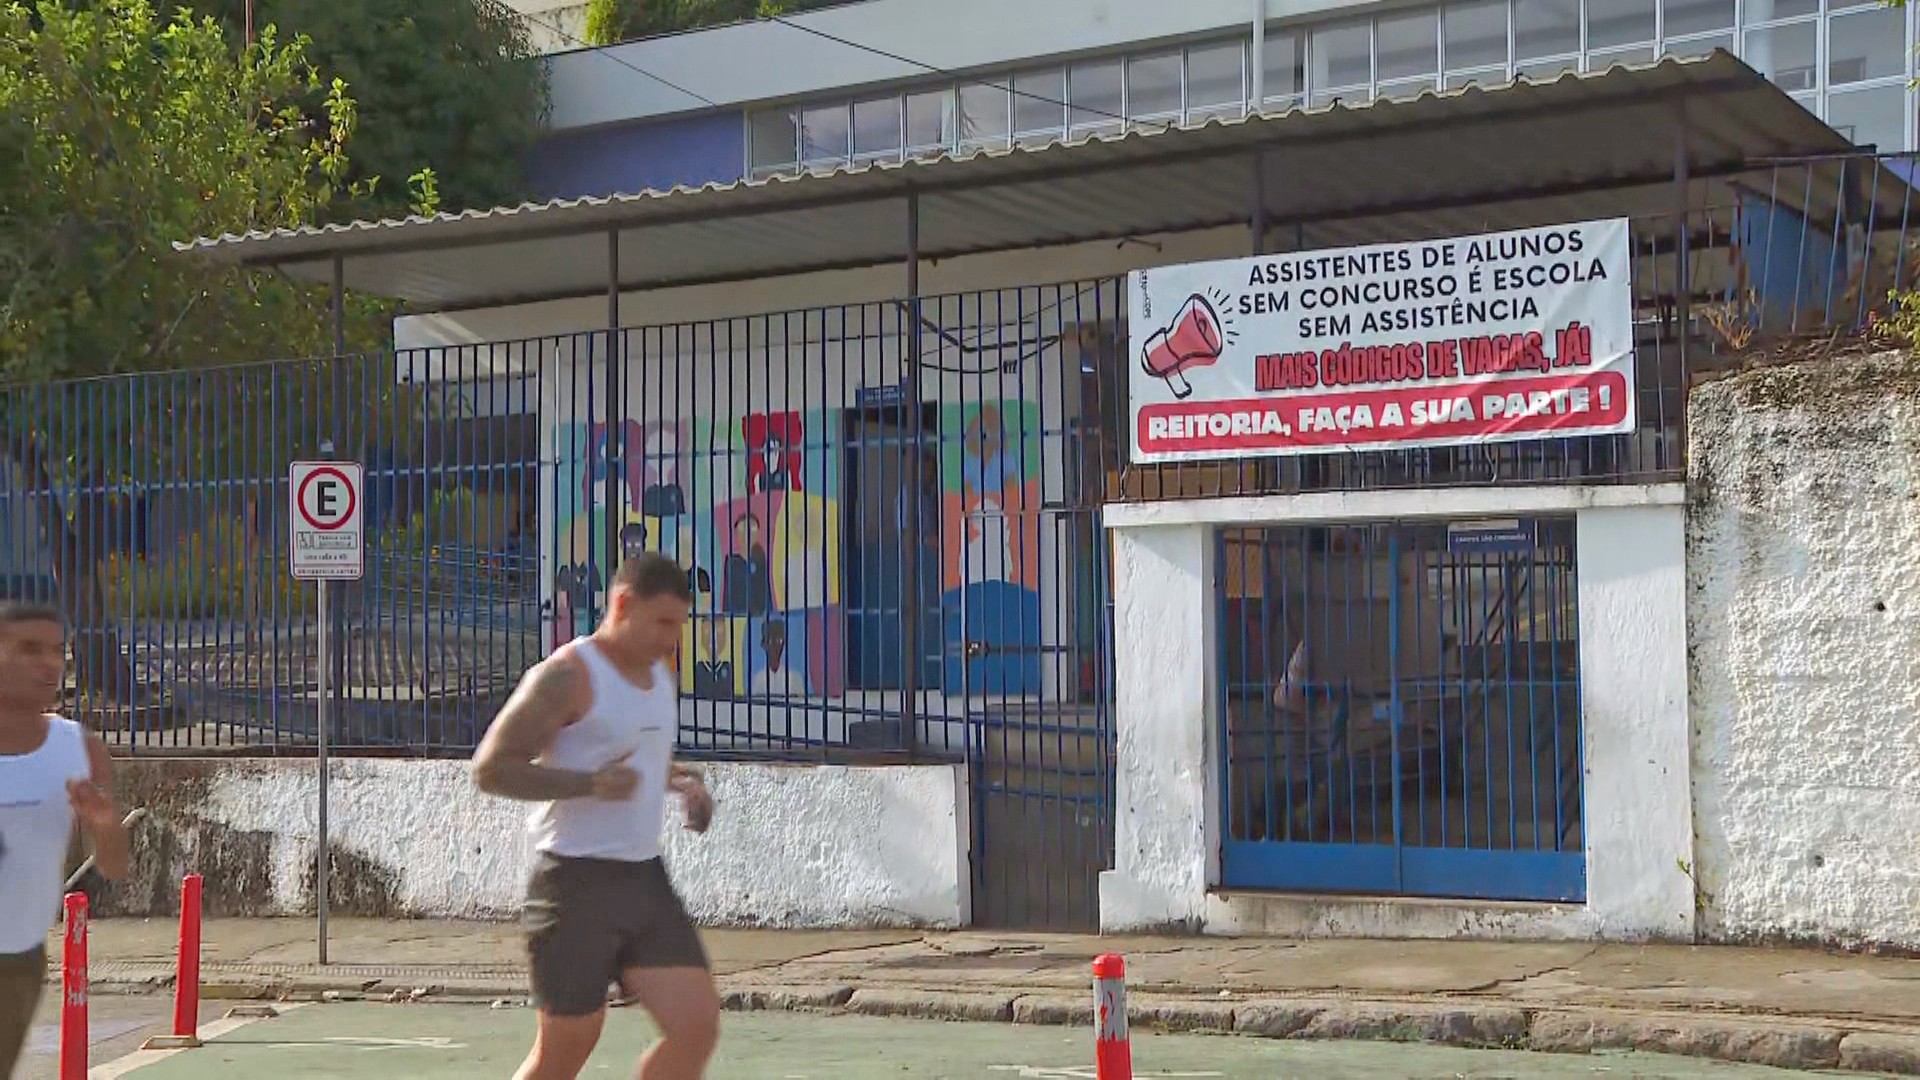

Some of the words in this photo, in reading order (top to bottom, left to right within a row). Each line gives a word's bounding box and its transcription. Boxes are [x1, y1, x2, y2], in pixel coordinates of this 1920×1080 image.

[1249, 249, 1412, 287] ASSISTENTES
[1423, 245, 1456, 268] DE
[1467, 229, 1583, 264] ALUNOS
[1239, 290, 1289, 315] SEM
[1300, 274, 1457, 310] CONCURSO
[1468, 265, 1482, 294] É
[1493, 258, 1607, 291] ESCOLA
[1299, 313, 1351, 339] SEM
[1360, 296, 1539, 334] ASSISTÊNCIA
[1255, 351, 1318, 391] MAIS
[1320, 341, 1424, 388] CÓDIGOS
[1426, 339, 1458, 378] DE
[1459, 331, 1550, 374] VAGAS,
[1553, 321, 1592, 367] JÁ!
[1149, 410, 1292, 440] REITORIA,
[1298, 405, 1375, 435] FAÇA
[1379, 402, 1404, 427] A
[1410, 397, 1476, 426] SUA
[1482, 387, 1590, 421] PARTE
[1599, 384, 1611, 411] !
[317, 480, 337, 517] E
